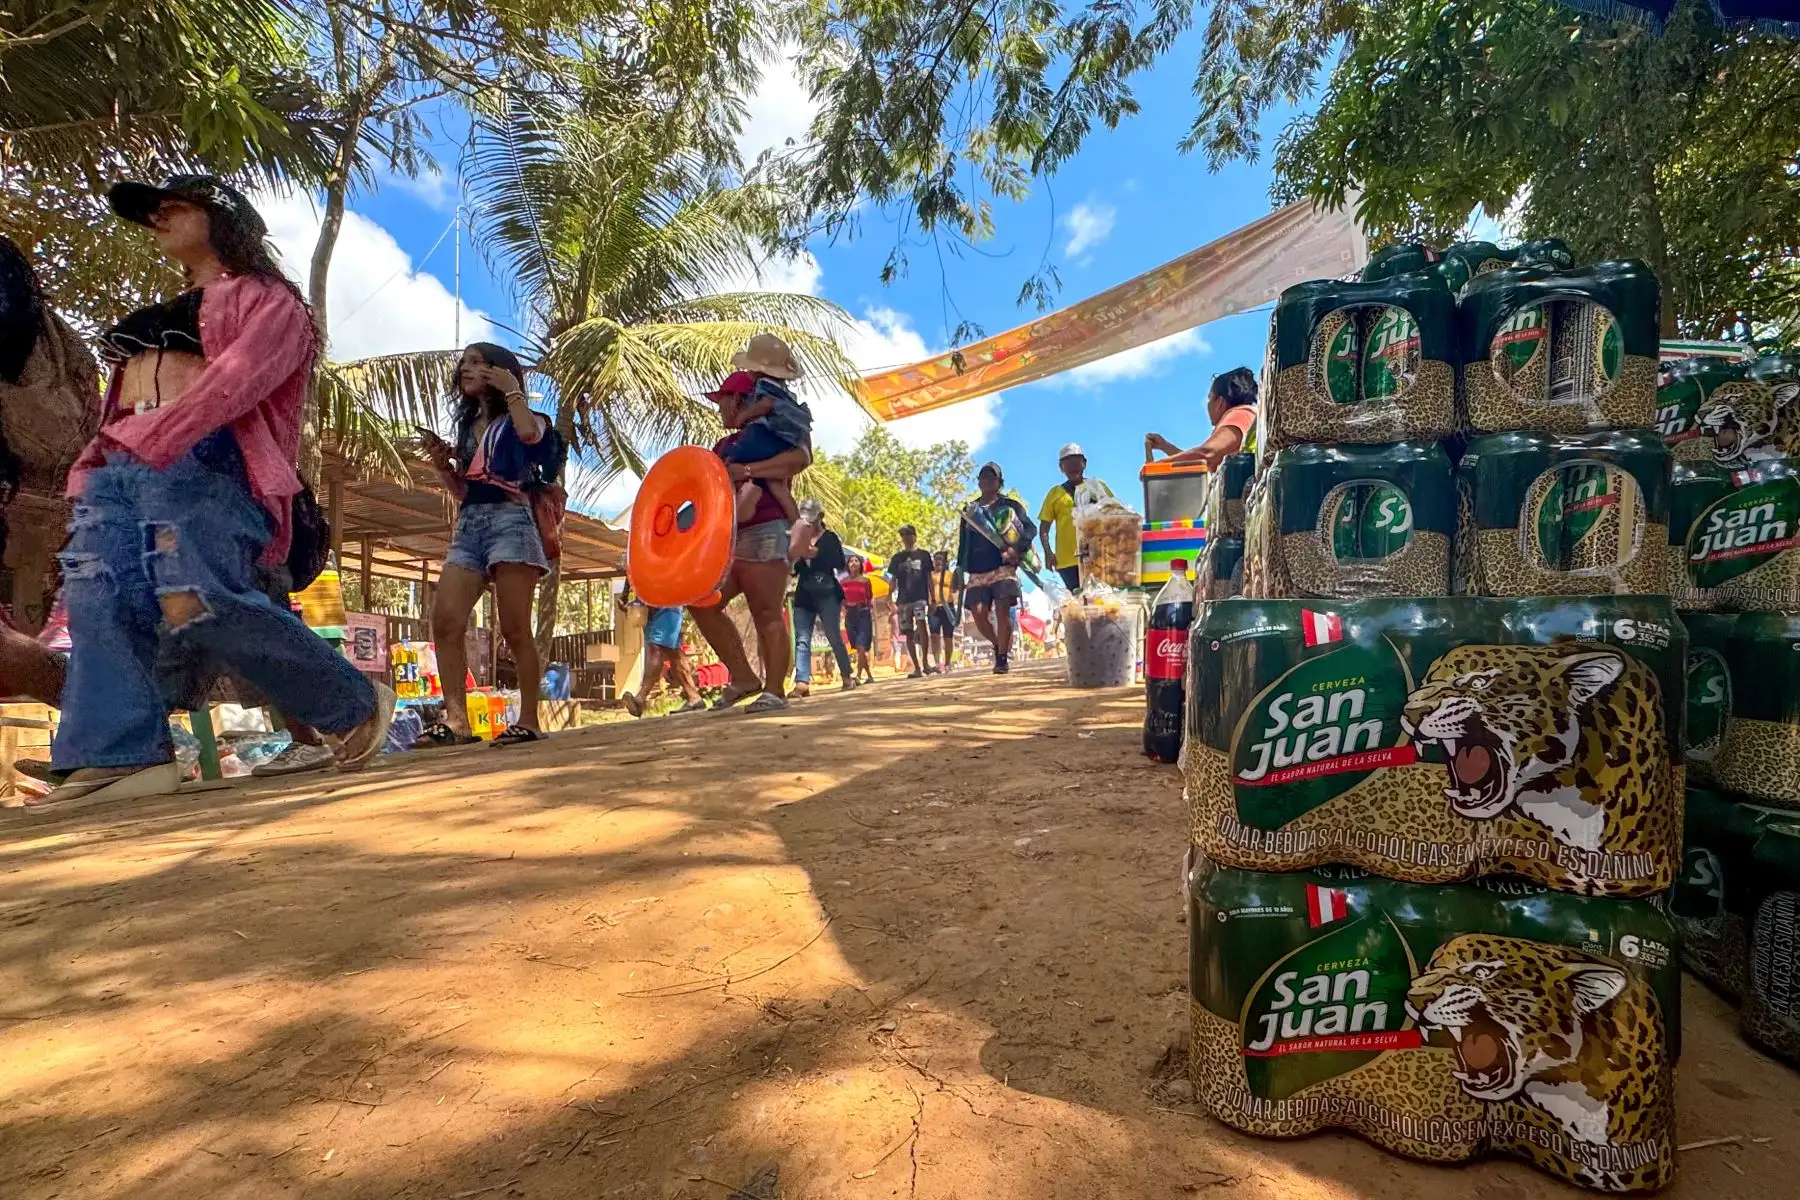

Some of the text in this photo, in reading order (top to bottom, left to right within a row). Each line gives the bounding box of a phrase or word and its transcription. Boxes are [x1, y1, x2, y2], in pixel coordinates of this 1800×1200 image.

[210, 185, 236, 211] LA
[1707, 503, 1776, 533] San
[1690, 520, 1787, 560] Juan
[1613, 618, 1636, 640] 6
[1638, 620, 1670, 636] LATAS
[1638, 632, 1655, 643] 355
[1656, 639, 1668, 648] ml
[1312, 676, 1365, 692] CERVEZA
[1264, 688, 1366, 739] San
[1238, 718, 1384, 781] Juan
[1271, 752, 1393, 782] EL SABOR NATURAL DE LA SELVA
[1216, 811, 1660, 880] TOMAR BEBIDAS ALCOHÓLICAS EN EXCESO ES DAÑINO.
[1582, 946, 1602, 955] Neto
[1620, 934, 1671, 958] 6 LATAS
[1640, 952, 1656, 964] 355
[1316, 958, 1370, 972] CERVEZA
[1771, 951, 1792, 997] EXCESO
[1270, 969, 1370, 1011] San
[1250, 1000, 1388, 1052] Juan
[1278, 1034, 1399, 1053] EL SABOR NATURAL DE LA SELVA
[1226, 1084, 1658, 1172] TOMAR BEBIDAS ALCOHÓLICAS EN EXCESO ES DAÑINO
